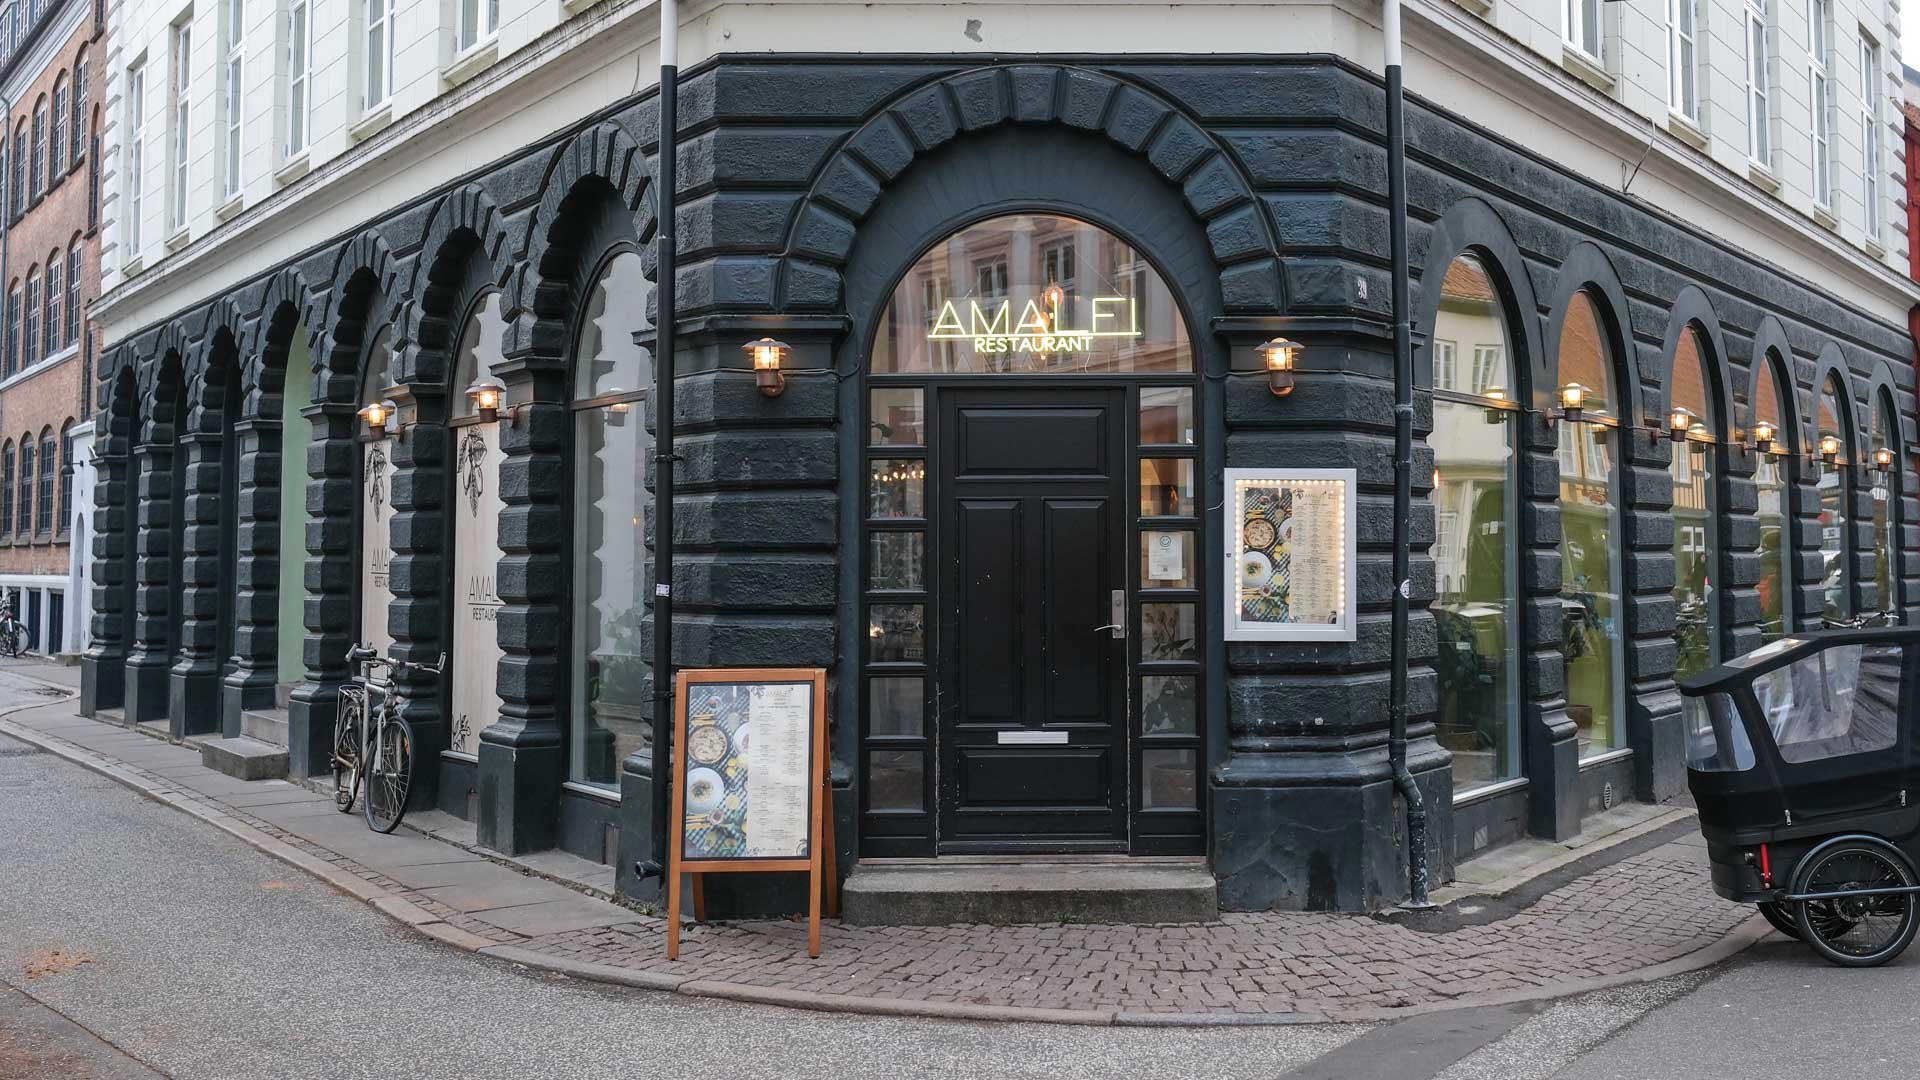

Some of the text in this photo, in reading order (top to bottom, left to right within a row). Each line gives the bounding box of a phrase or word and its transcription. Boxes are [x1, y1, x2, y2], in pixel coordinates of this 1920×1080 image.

[931, 297, 1136, 336] AMALFI
[974, 336, 1093, 353] RESTAURANT
[468, 575, 499, 602] AMAL
[472, 607, 497, 621] RESTAURA
